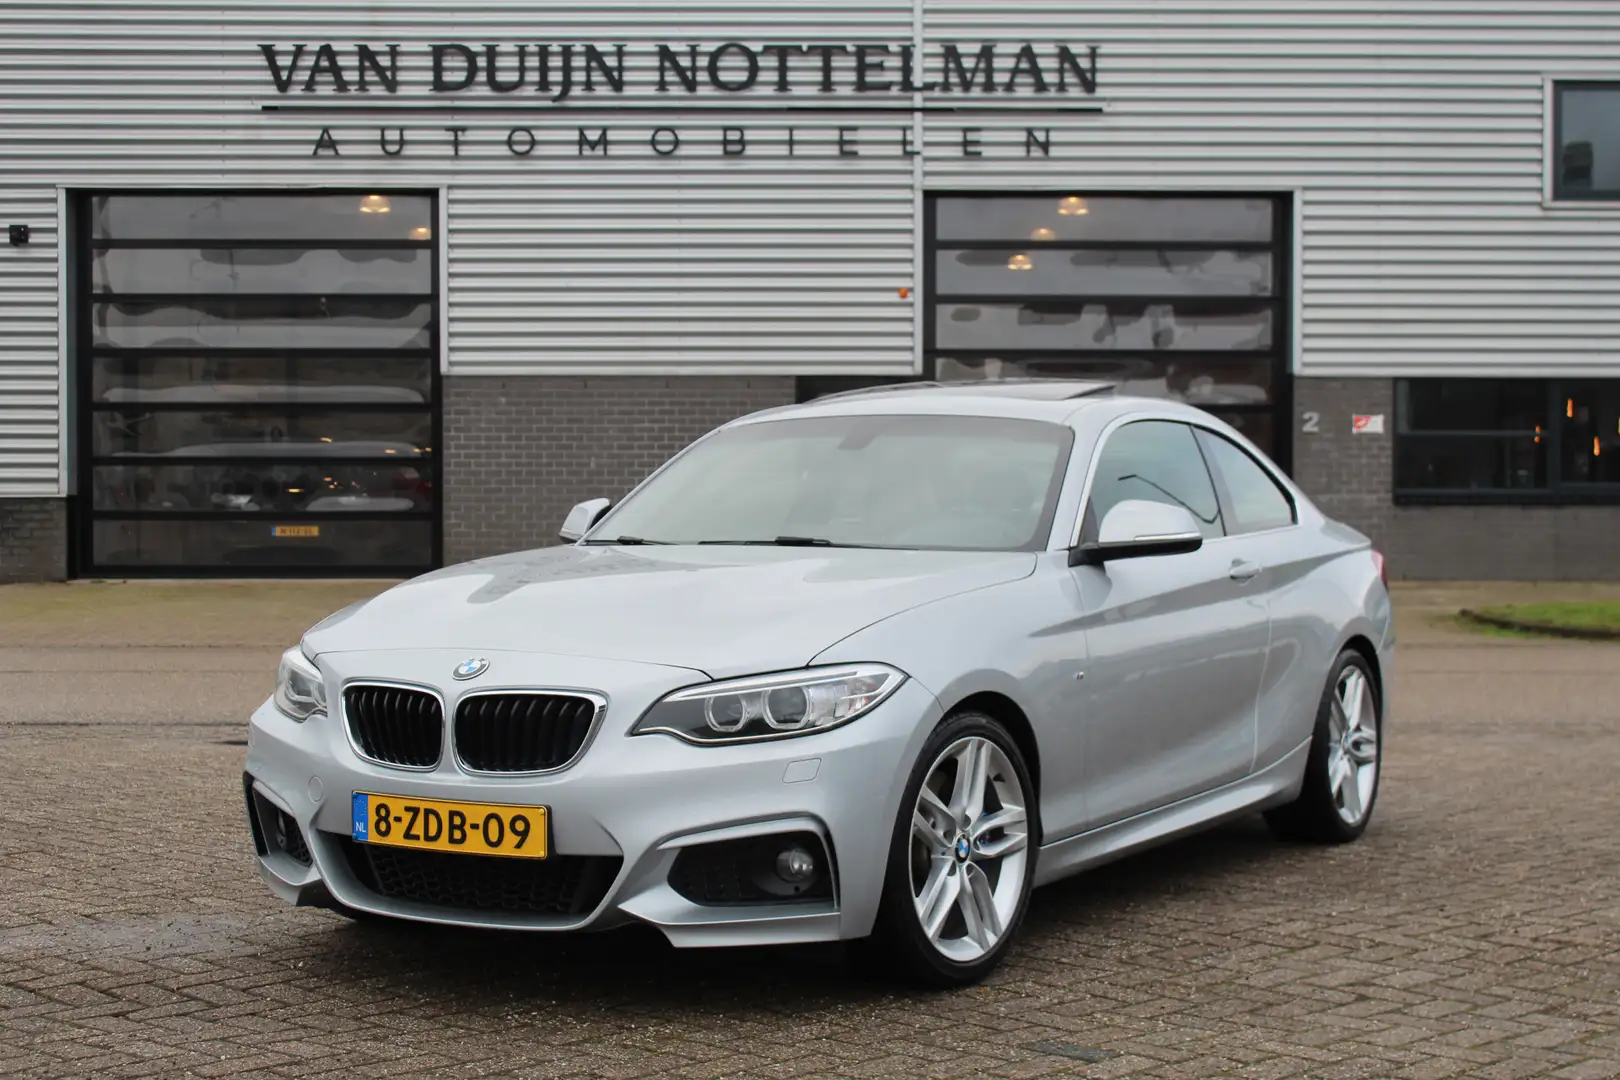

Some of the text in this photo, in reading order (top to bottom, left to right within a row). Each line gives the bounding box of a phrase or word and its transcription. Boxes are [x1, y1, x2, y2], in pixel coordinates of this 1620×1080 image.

[257, 42, 1099, 102] VAN DUIJN NOTTELMAN
[312, 126, 1051, 158] AUTOMOBIELEN
[1302, 412, 1319, 432] 2
[355, 803, 531, 849] NL 8-ZDB-09
